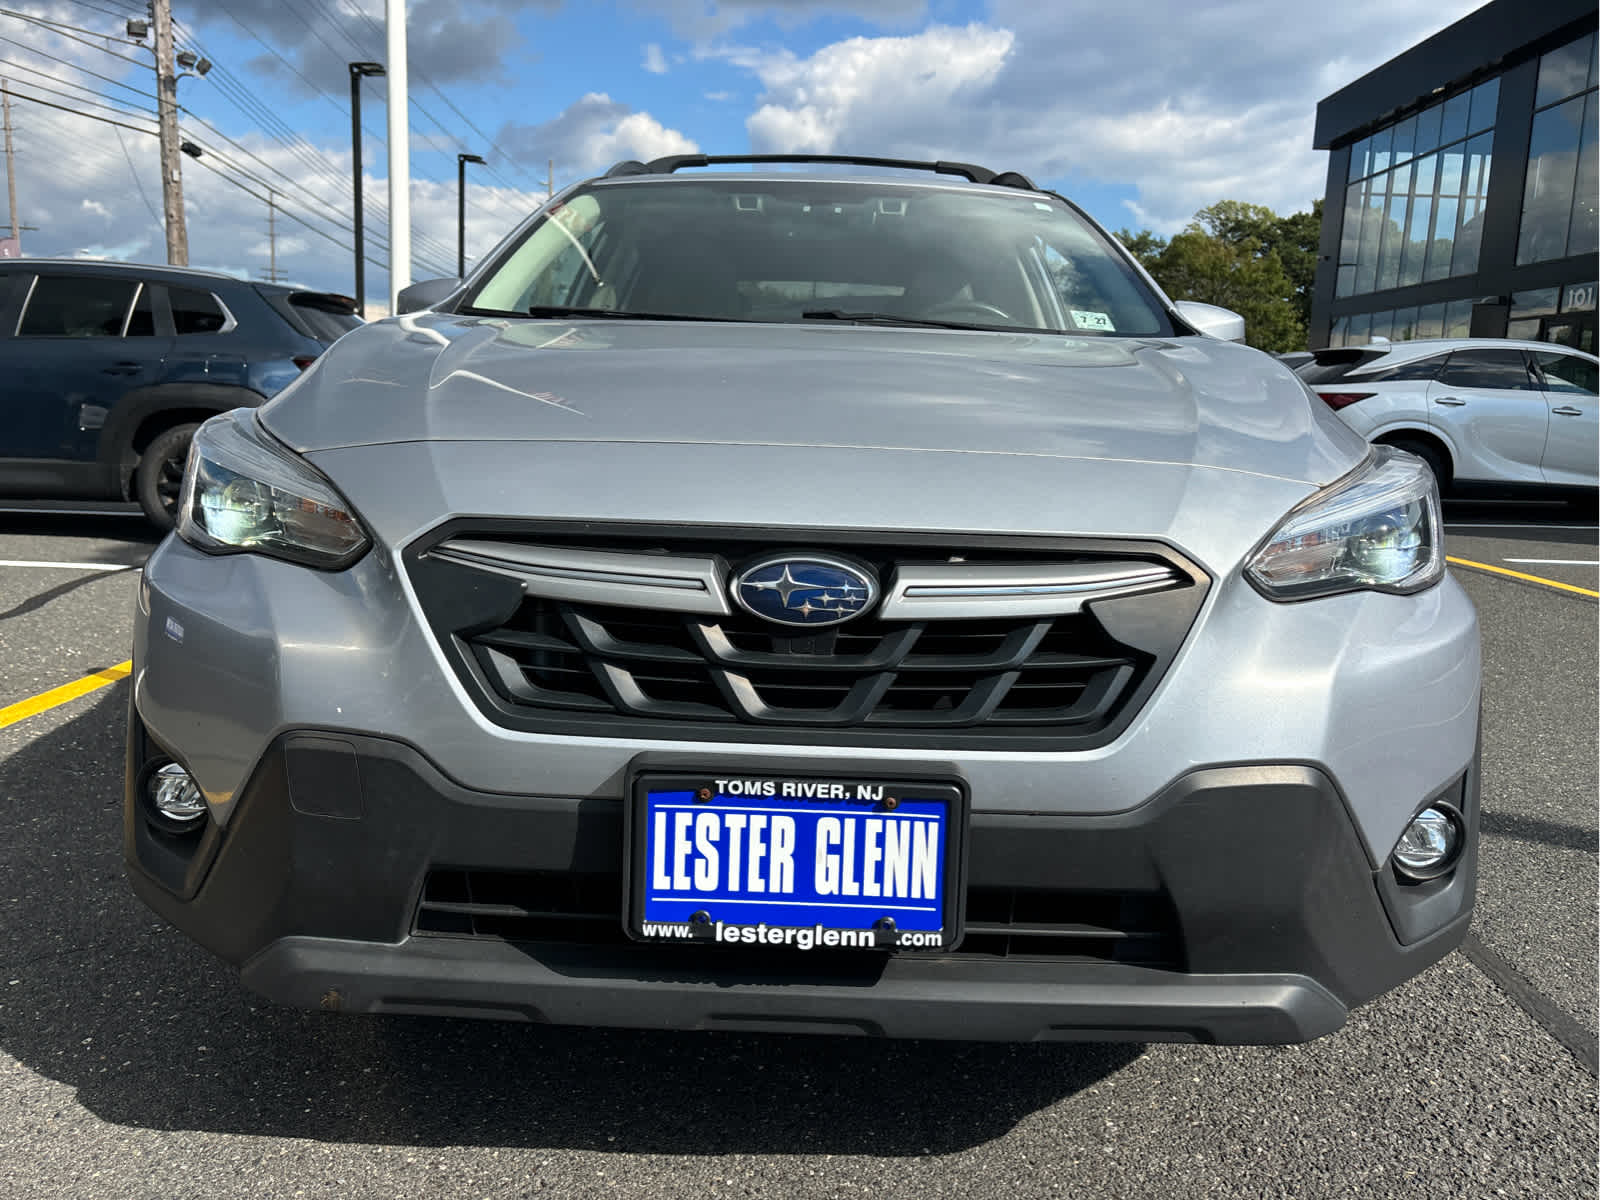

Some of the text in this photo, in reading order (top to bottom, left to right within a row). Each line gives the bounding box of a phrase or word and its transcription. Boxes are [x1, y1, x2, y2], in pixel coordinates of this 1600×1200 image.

[1568, 287, 1593, 308] 101
[715, 779, 884, 801] TOMS RIVER, NJ
[652, 811, 939, 900] LESTER GLENN
[642, 921, 943, 950] www. lesterglenn .com
